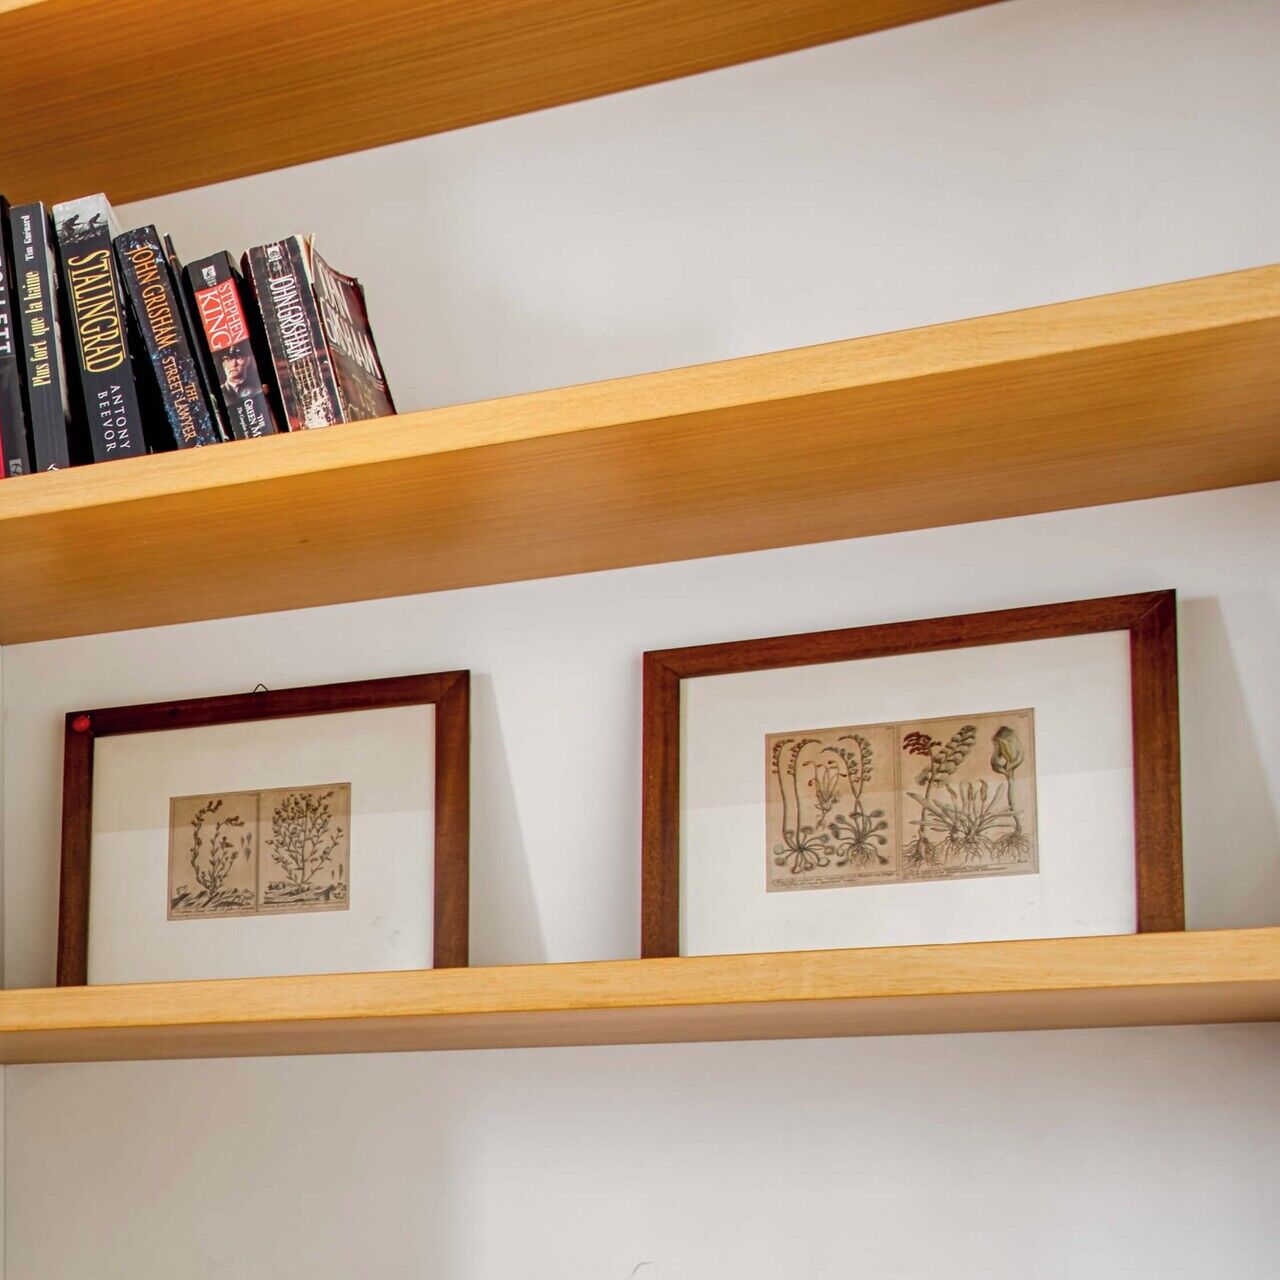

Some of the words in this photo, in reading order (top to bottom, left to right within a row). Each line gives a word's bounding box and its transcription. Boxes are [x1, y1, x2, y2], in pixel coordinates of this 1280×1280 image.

[22, 270, 42, 301] haine
[124, 242, 161, 286] JOHN
[24, 300, 44, 314] la
[67, 249, 126, 374] STALINGRAD
[218, 282, 247, 343] STEPHEN
[268, 273, 302, 314] JOHN
[30, 316, 50, 337] que
[141, 284, 179, 350] GRISHAM
[198, 288, 232, 350] KING
[276, 306, 313, 363] GRISHAM
[28, 339, 49, 362] fort
[31, 362, 52, 388] Plus
[184, 382, 199, 403] THE
[109, 385, 131, 449] ANTONY
[161, 355, 185, 397] STREET
[173, 396, 198, 442] LAWYER
[243, 398, 258, 423] GREEN
[97, 390, 117, 452] BEEVOR
